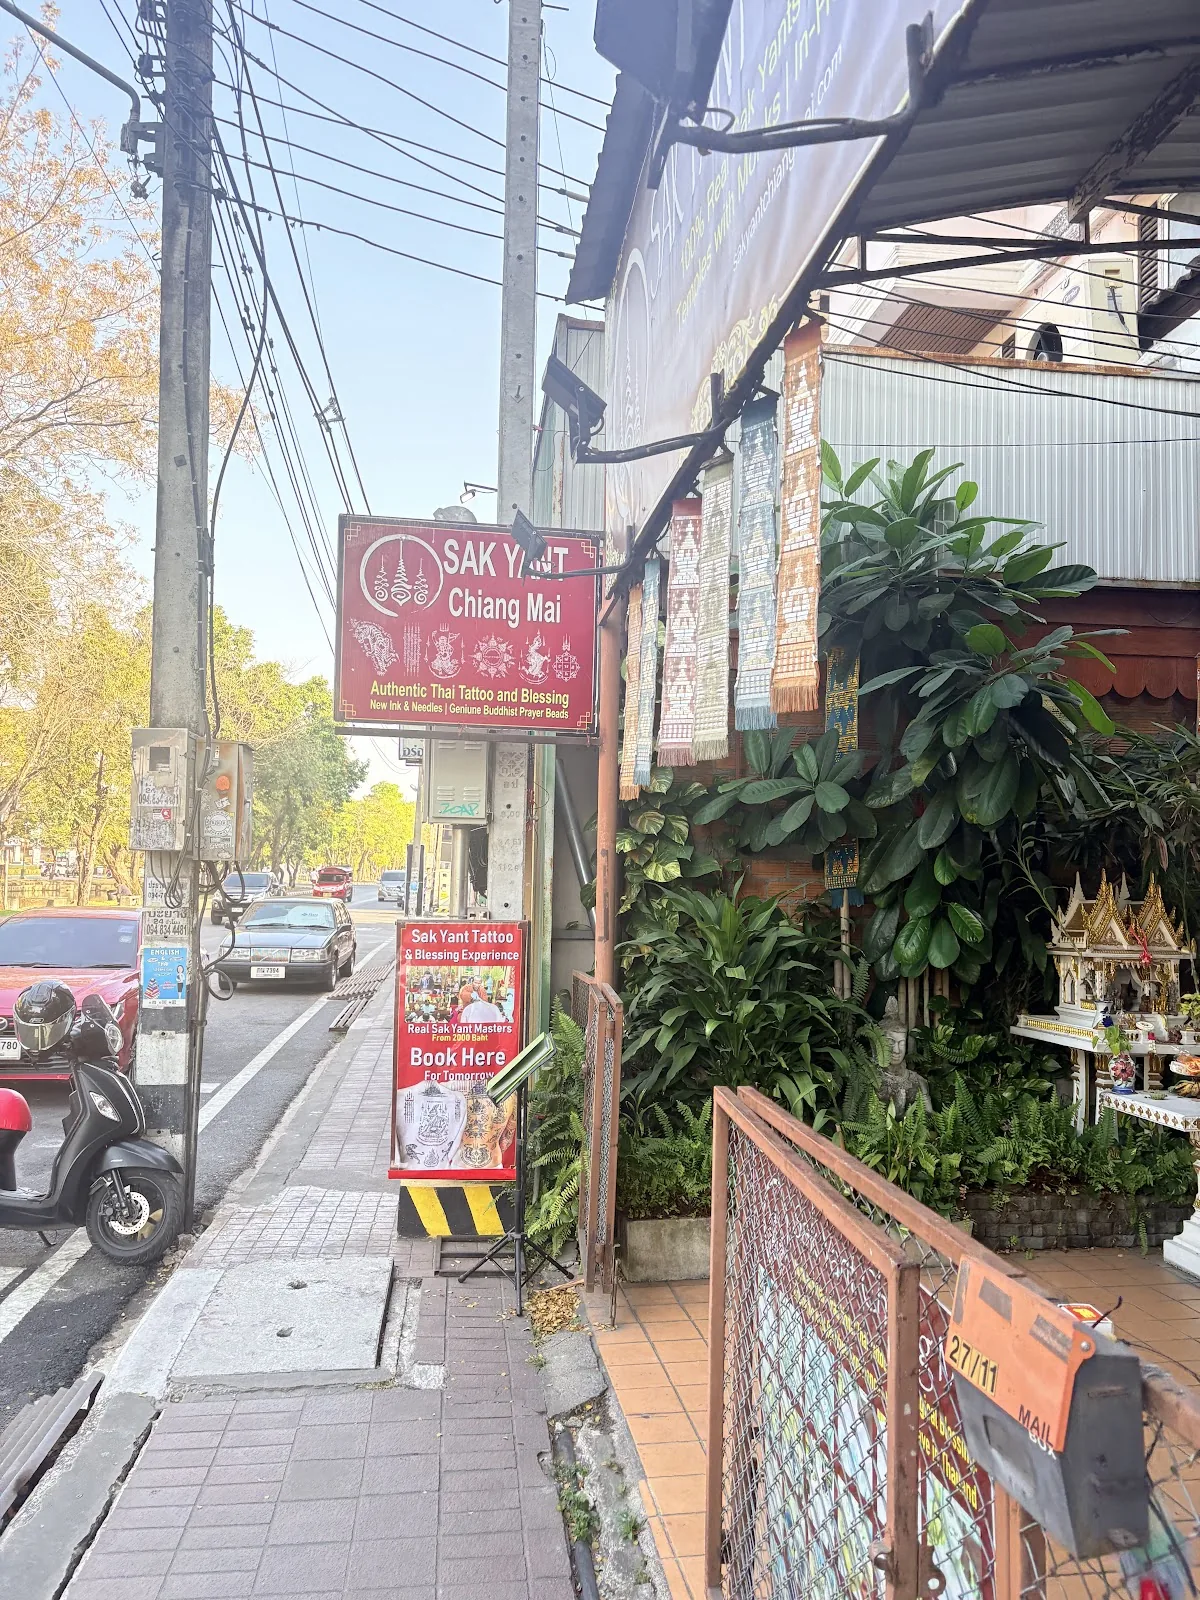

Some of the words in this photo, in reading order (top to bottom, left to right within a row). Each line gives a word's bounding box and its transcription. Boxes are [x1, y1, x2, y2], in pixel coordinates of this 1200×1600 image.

[733, 43, 843, 272] sakyantchiangai.com
[680, 205, 705, 278] 100%
[676, 243, 712, 334] Temples
[714, 190, 736, 252] with
[443, 538, 497, 577] SAK
[448, 587, 520, 628] Chiang
[527, 592, 561, 623] Mai
[370, 680, 427, 698] Authentic
[430, 683, 455, 699] Thai
[458, 685, 494, 701] Tattoo
[497, 688, 518, 702] and
[521, 688, 569, 708] Blessing
[370, 699, 387, 710] New
[389, 700, 401, 711] Ink
[403, 701, 409, 711] &
[411, 701, 443, 713] Needles
[449, 703, 481, 715] Geniune
[483, 705, 518, 716] Buddhist
[519, 707, 544, 719] Prayer
[545, 708, 569, 719] Beads
[159, 924, 171, 935] 834
[172, 924, 187, 935] 4481
[411, 929, 438, 943] Sak
[440, 929, 470, 943] Yant
[471, 929, 514, 943] Tattoo
[404, 949, 413, 960] &
[415, 949, 459, 962] Blessing
[461, 949, 519, 962] Experience
[407, 1024, 429, 1034] Real
[431, 1024, 451, 1034] Sak
[451, 1024, 473, 1034] Yant
[474, 1024, 512, 1034] Masters
[410, 1047, 458, 1067] Book
[461, 1047, 506, 1066] Here
[424, 1070, 441, 1080] For
[443, 1070, 495, 1081] Tomorrow
[949, 1335, 997, 1393] 27/11
[1018, 1404, 1054, 1447] MAIL
